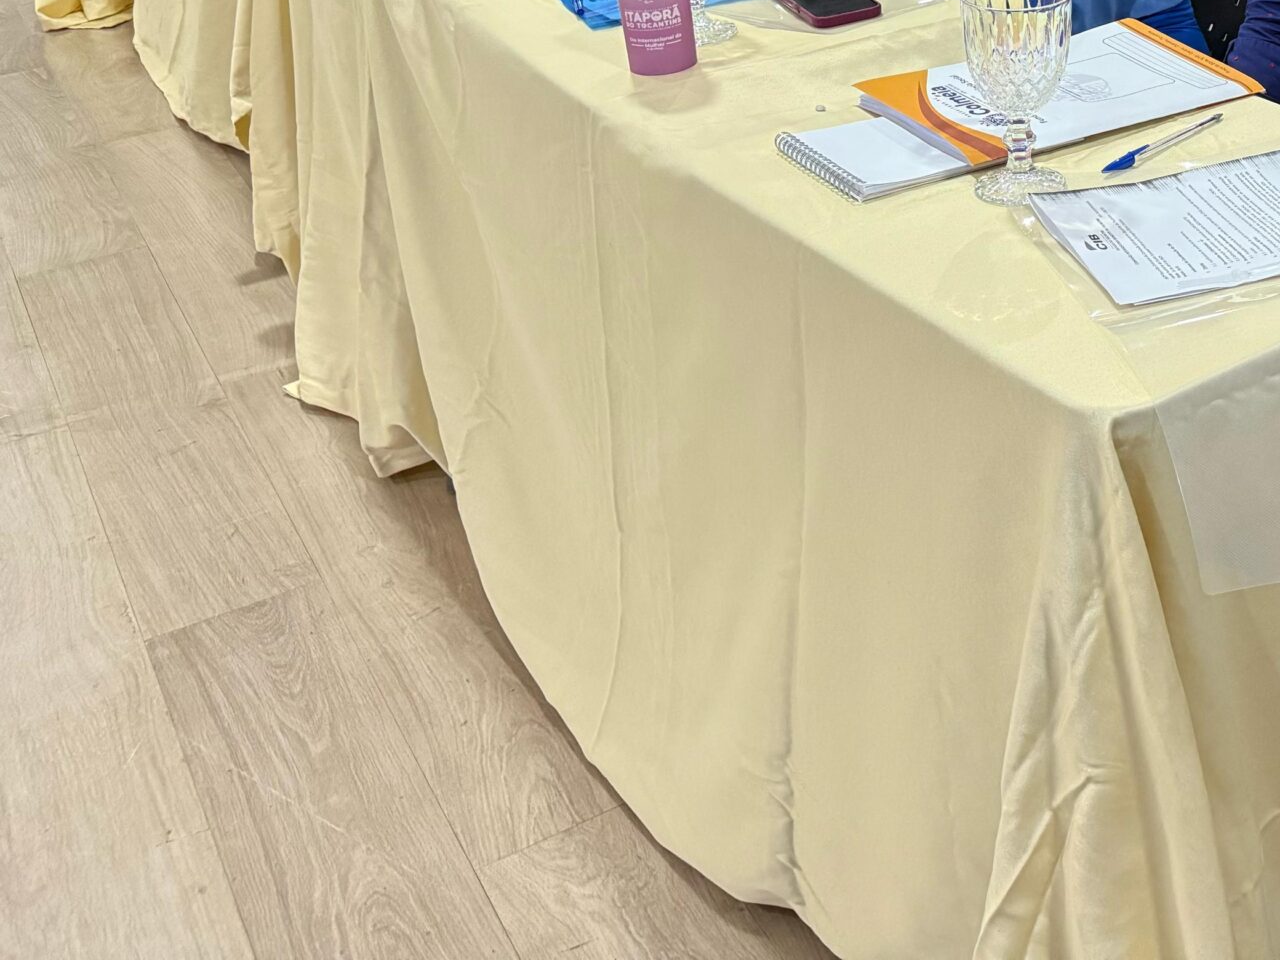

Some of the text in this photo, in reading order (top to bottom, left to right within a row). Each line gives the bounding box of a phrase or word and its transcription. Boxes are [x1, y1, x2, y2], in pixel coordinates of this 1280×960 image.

[624, 3, 681, 23] ITAPORÃ
[636, 17, 682, 29] TOCANTINS
[930, 85, 990, 116] Colmeia
